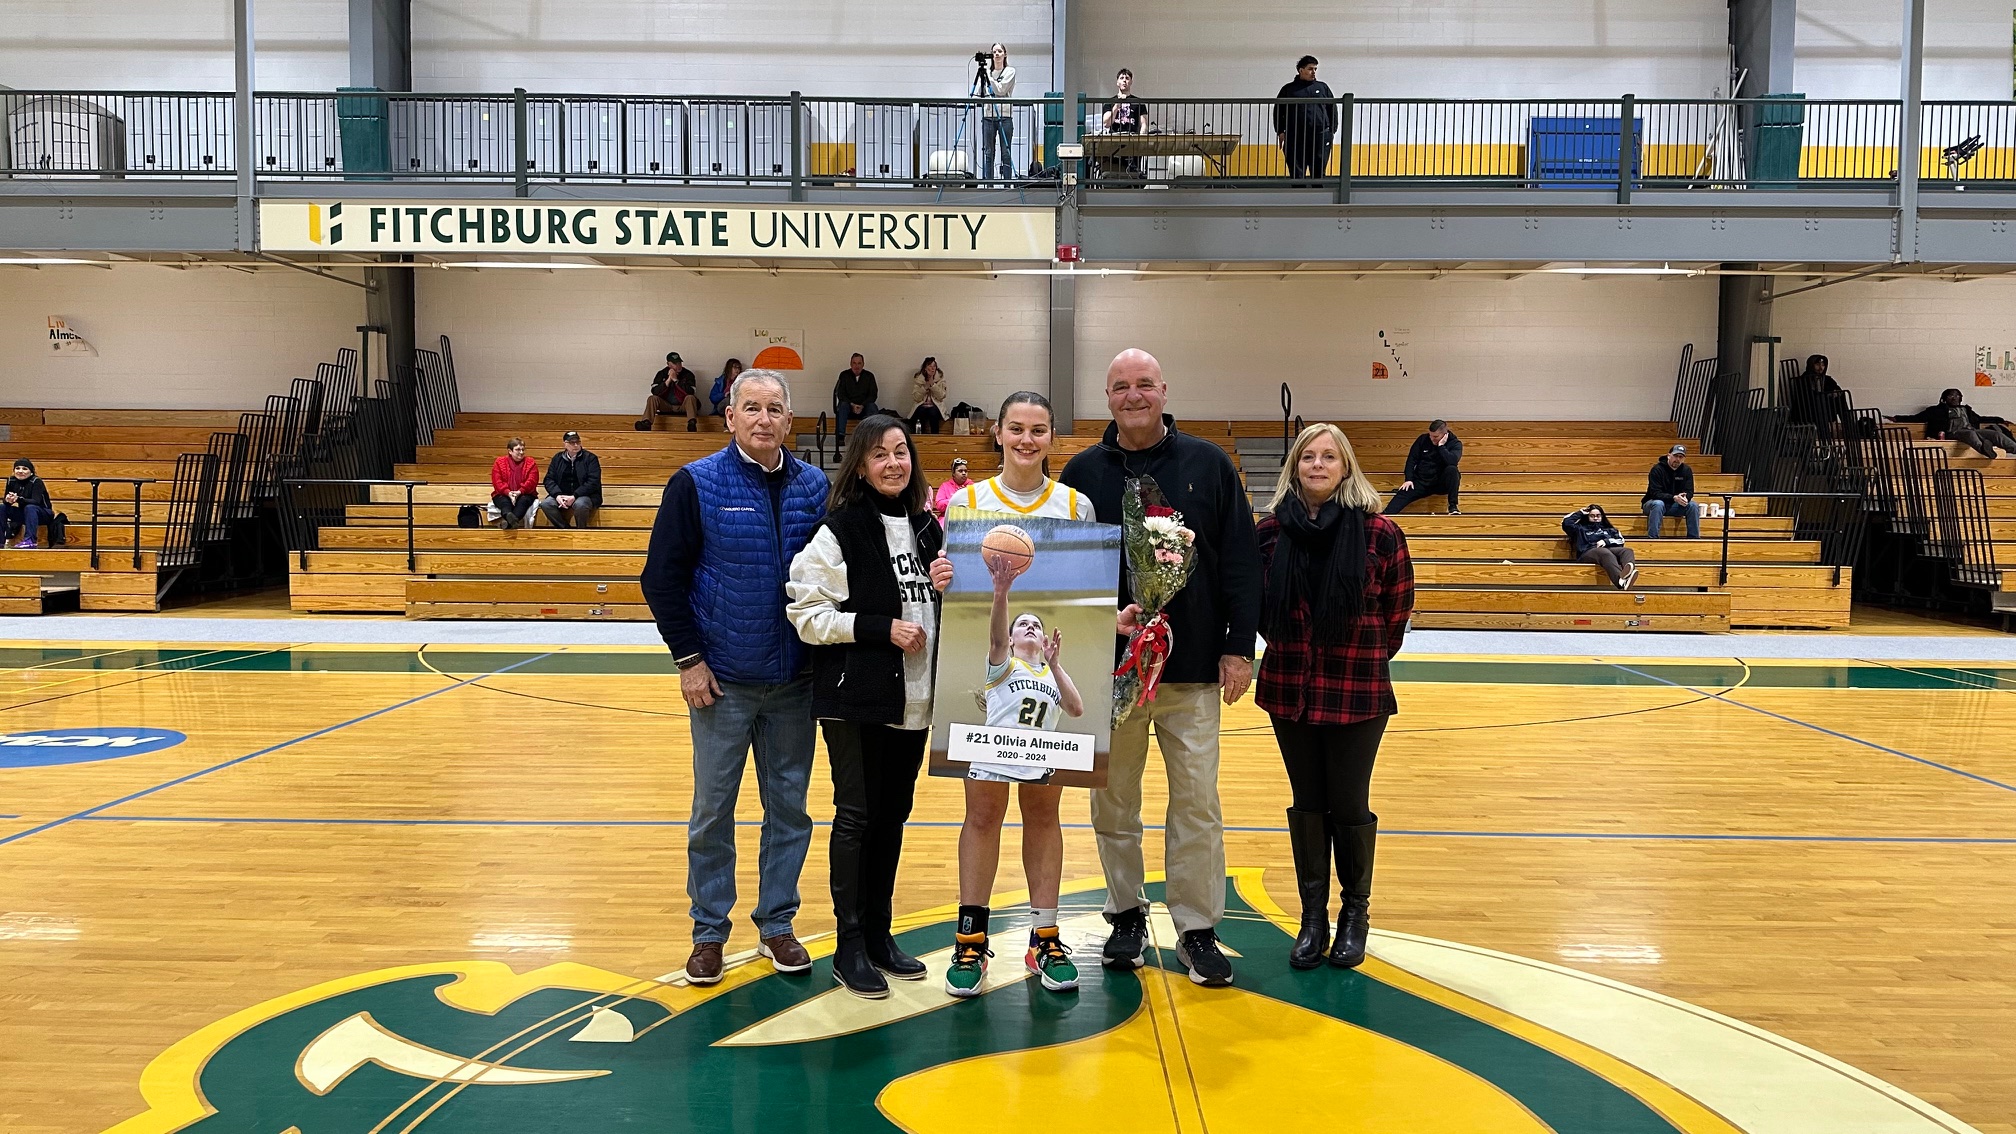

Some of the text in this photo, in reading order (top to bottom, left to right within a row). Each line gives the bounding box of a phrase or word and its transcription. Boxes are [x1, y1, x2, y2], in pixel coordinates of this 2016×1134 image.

[369, 207, 987, 250] FITCHBURG STATE UNIVERSITY
[1018, 697, 1048, 728] 21
[966, 732, 1079, 752] #21 Olivia Almeida
